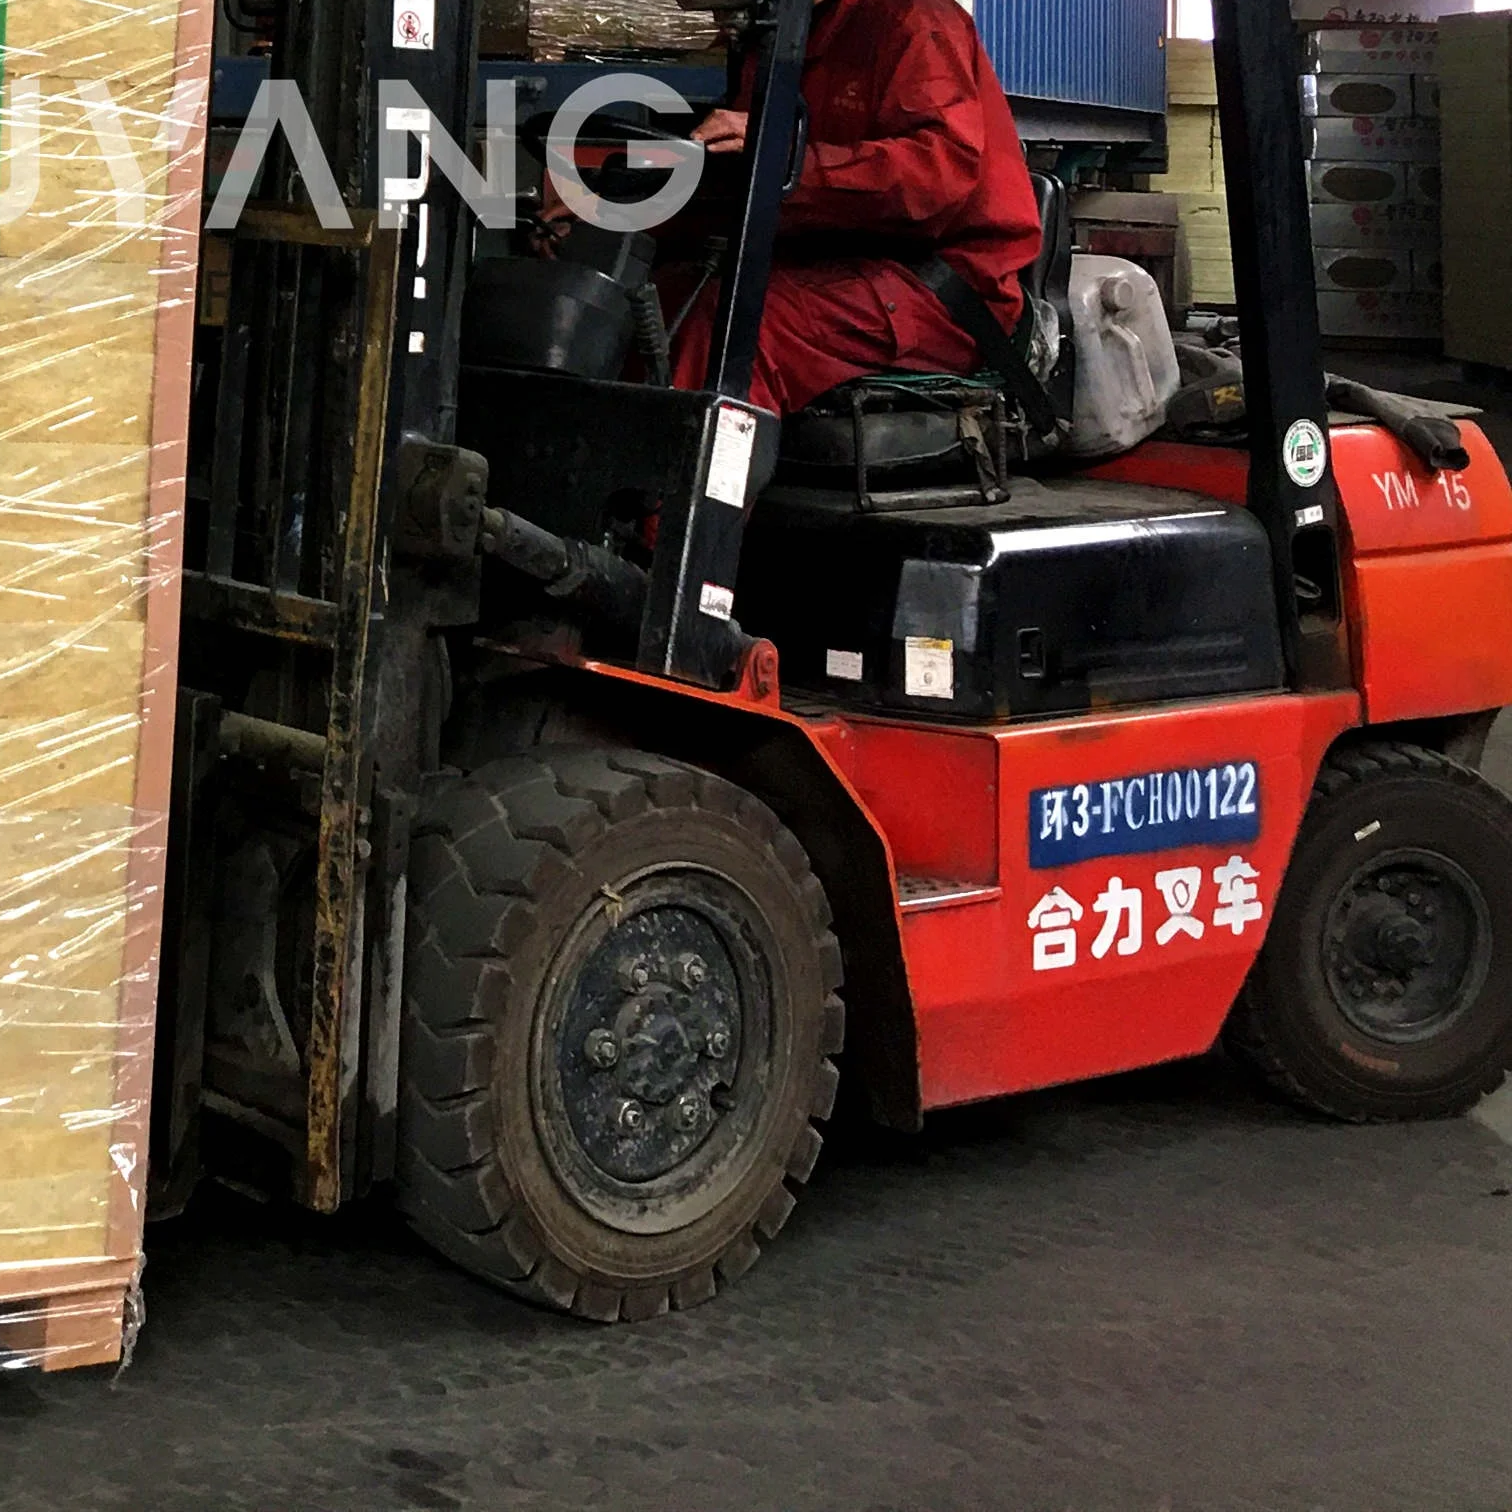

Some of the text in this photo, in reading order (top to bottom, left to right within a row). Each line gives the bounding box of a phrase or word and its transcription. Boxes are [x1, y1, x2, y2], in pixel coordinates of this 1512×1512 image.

[1371, 470, 1472, 510] YM 15
[1027, 854, 1264, 972] 合力叉车
